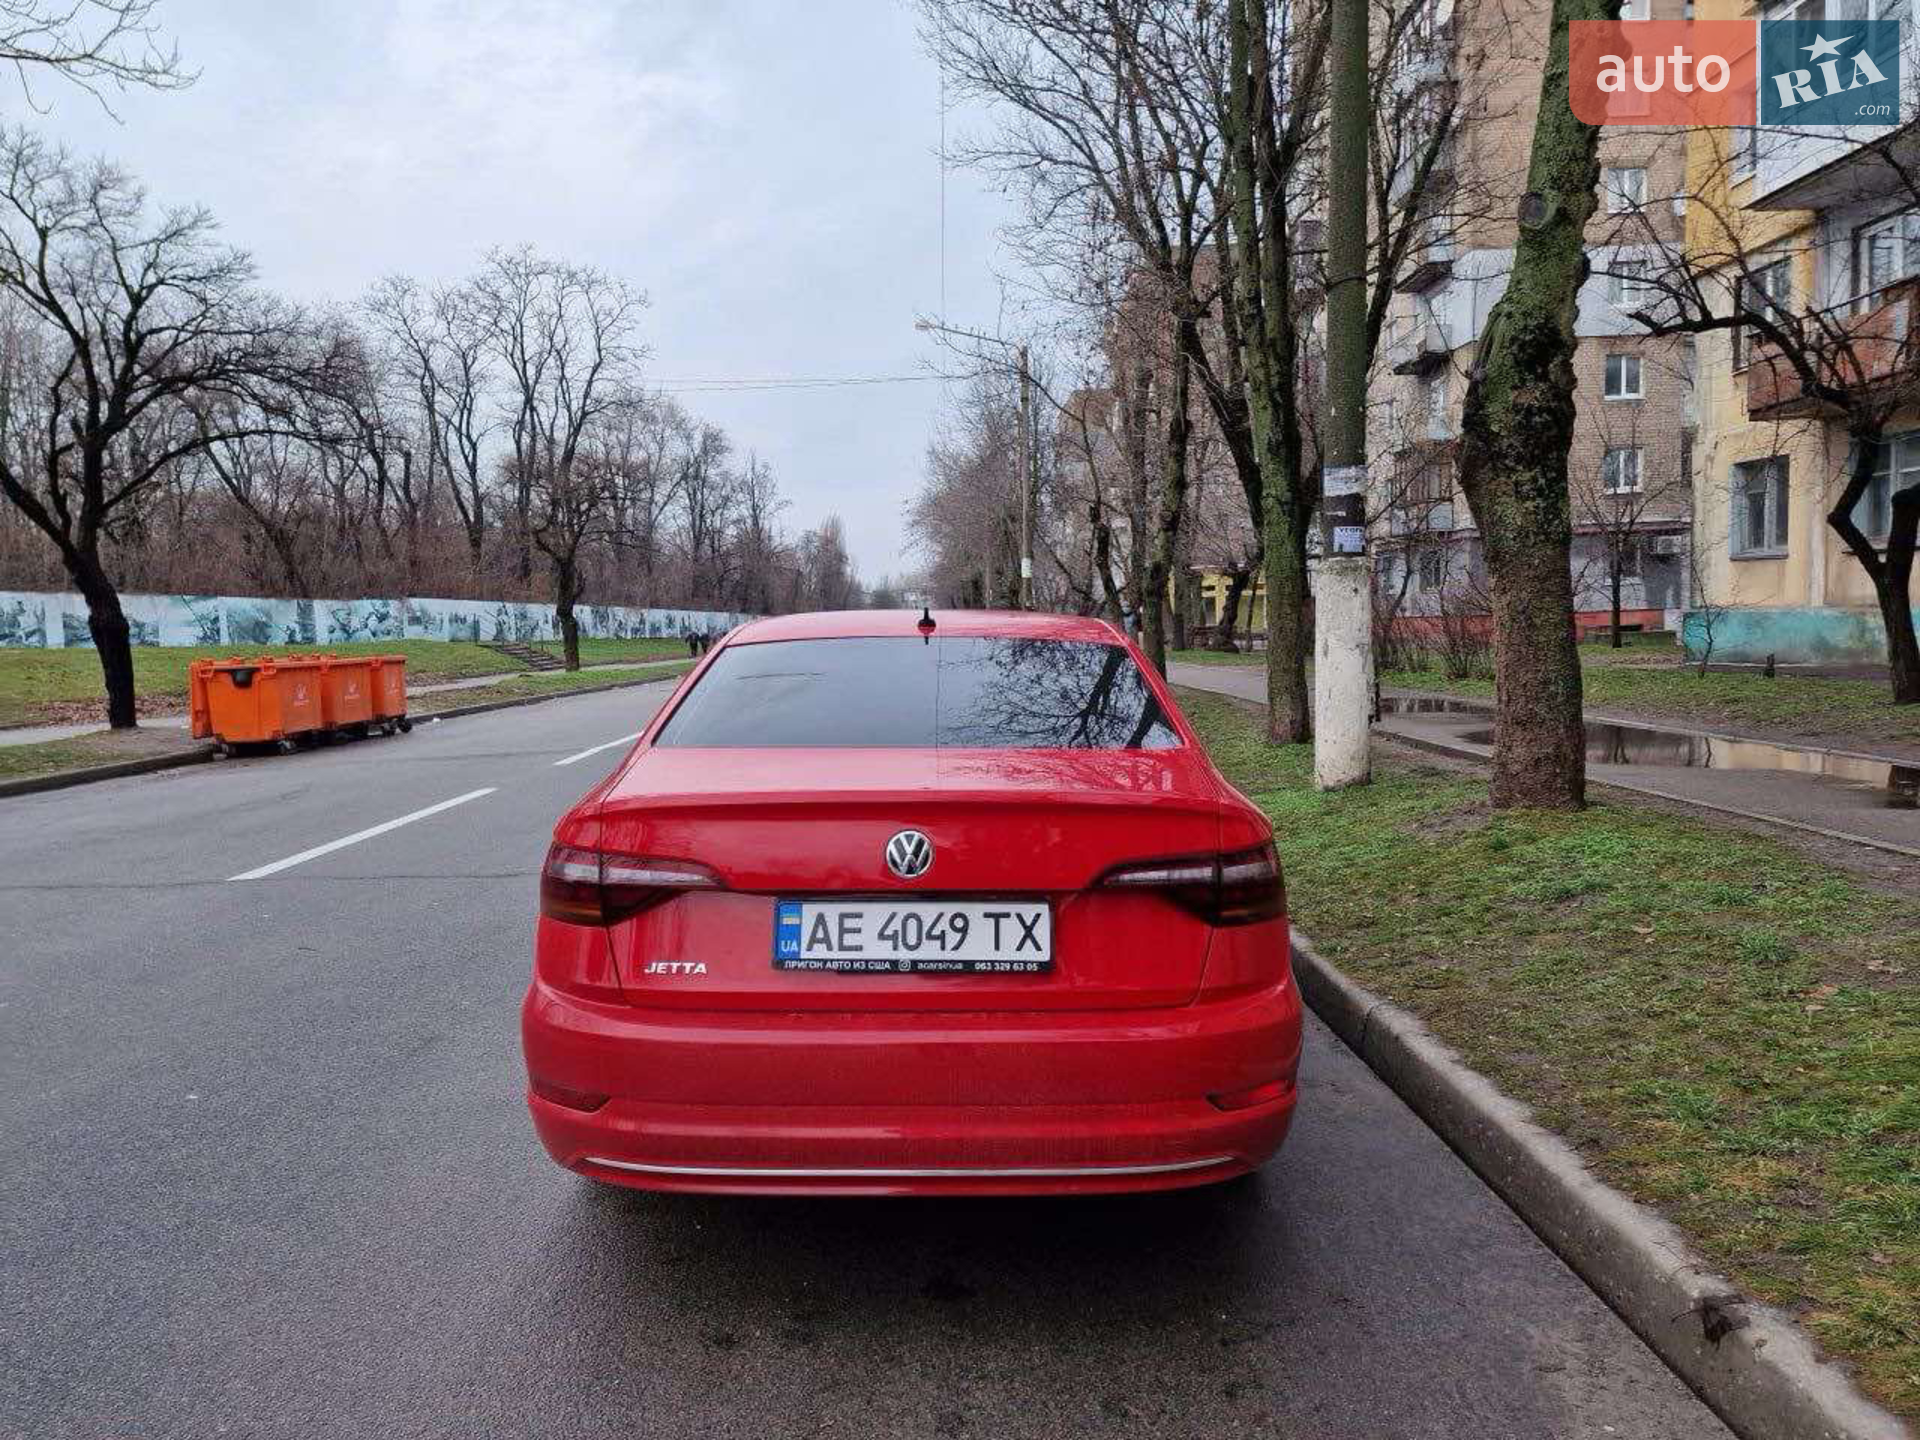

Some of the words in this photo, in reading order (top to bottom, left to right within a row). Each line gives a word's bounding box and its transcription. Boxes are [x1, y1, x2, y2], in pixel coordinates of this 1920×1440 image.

[805, 911, 864, 951] AE
[877, 911, 970, 952] 4049
[983, 911, 1043, 952] TX
[780, 940, 799, 953] UA
[644, 962, 707, 974] JETTA
[784, 960, 823, 970] ПРИГОН
[825, 960, 851, 970] АВТО
[853, 960, 867, 970] ИЗ
[868, 960, 891, 970] США
